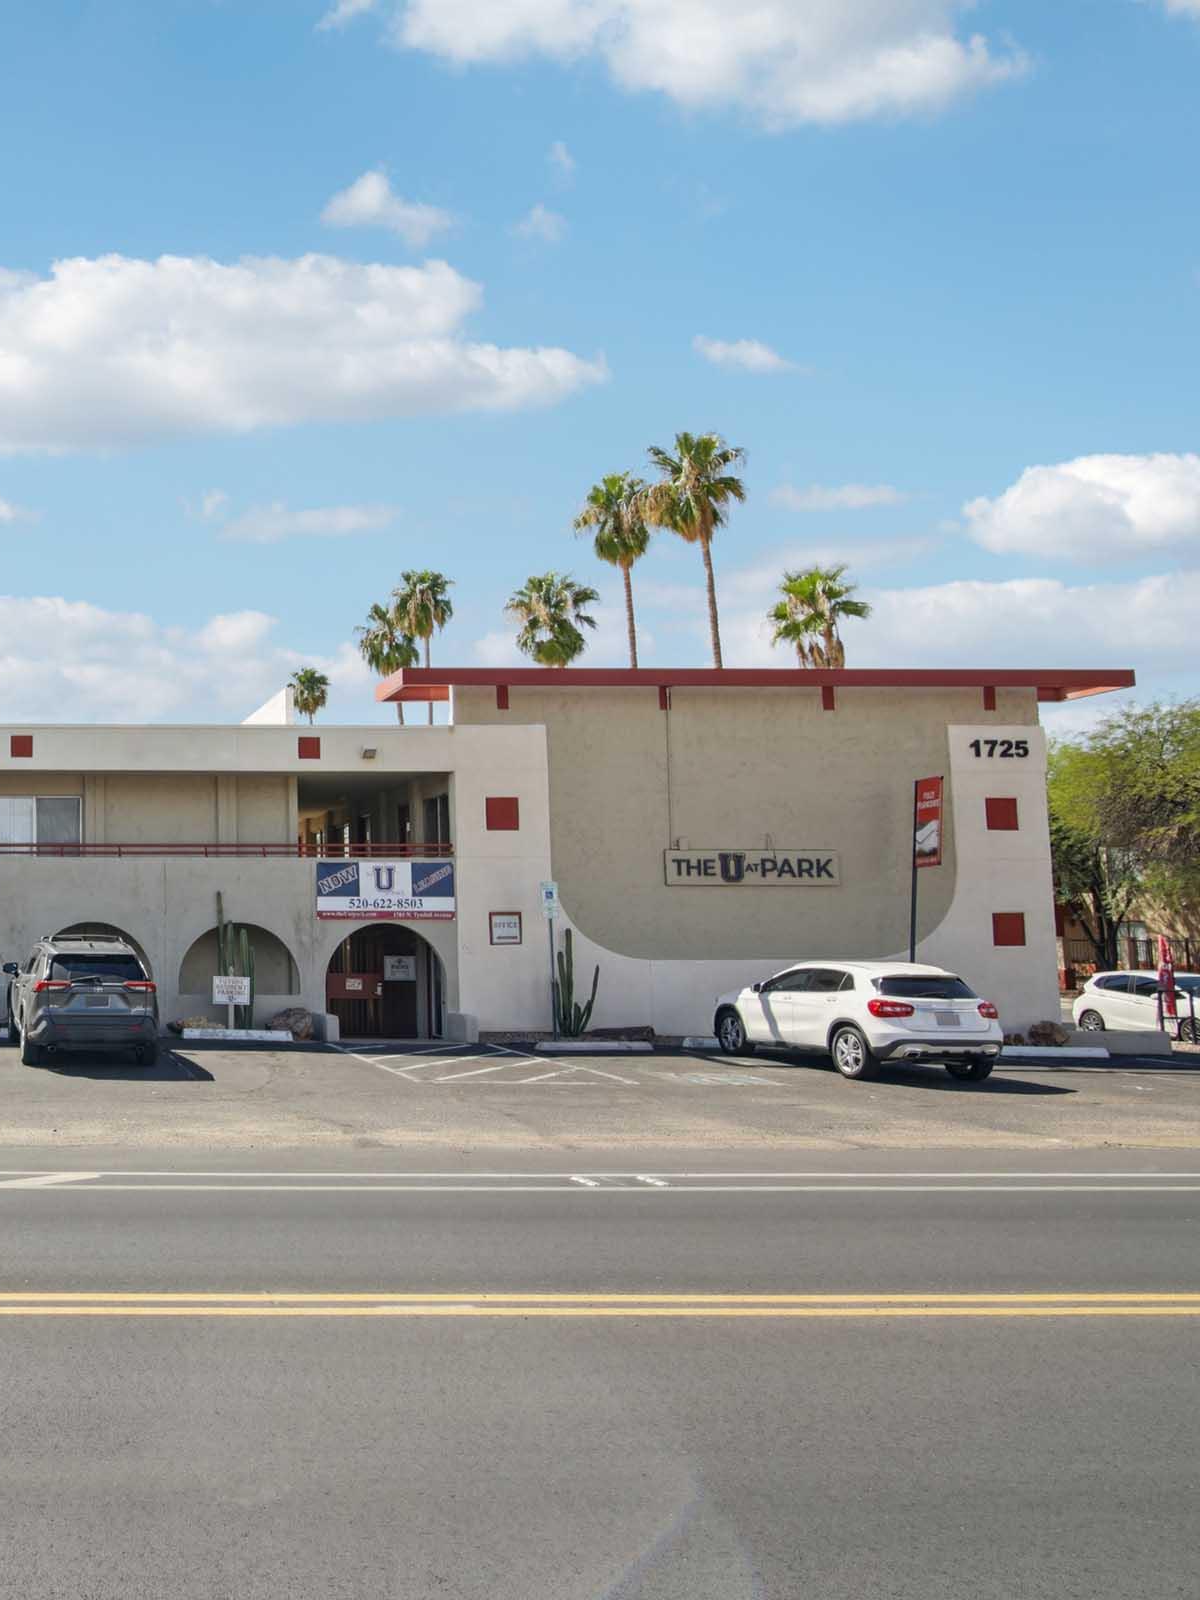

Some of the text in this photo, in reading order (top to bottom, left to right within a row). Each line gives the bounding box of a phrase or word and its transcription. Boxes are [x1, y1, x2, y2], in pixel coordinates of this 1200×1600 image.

[969, 739, 1029, 758] 1725
[319, 864, 359, 894] NOW
[373, 865, 396, 891] U
[672, 853, 834, 882] THE U AT PARK
[348, 899, 424, 909] 520-622-8503
